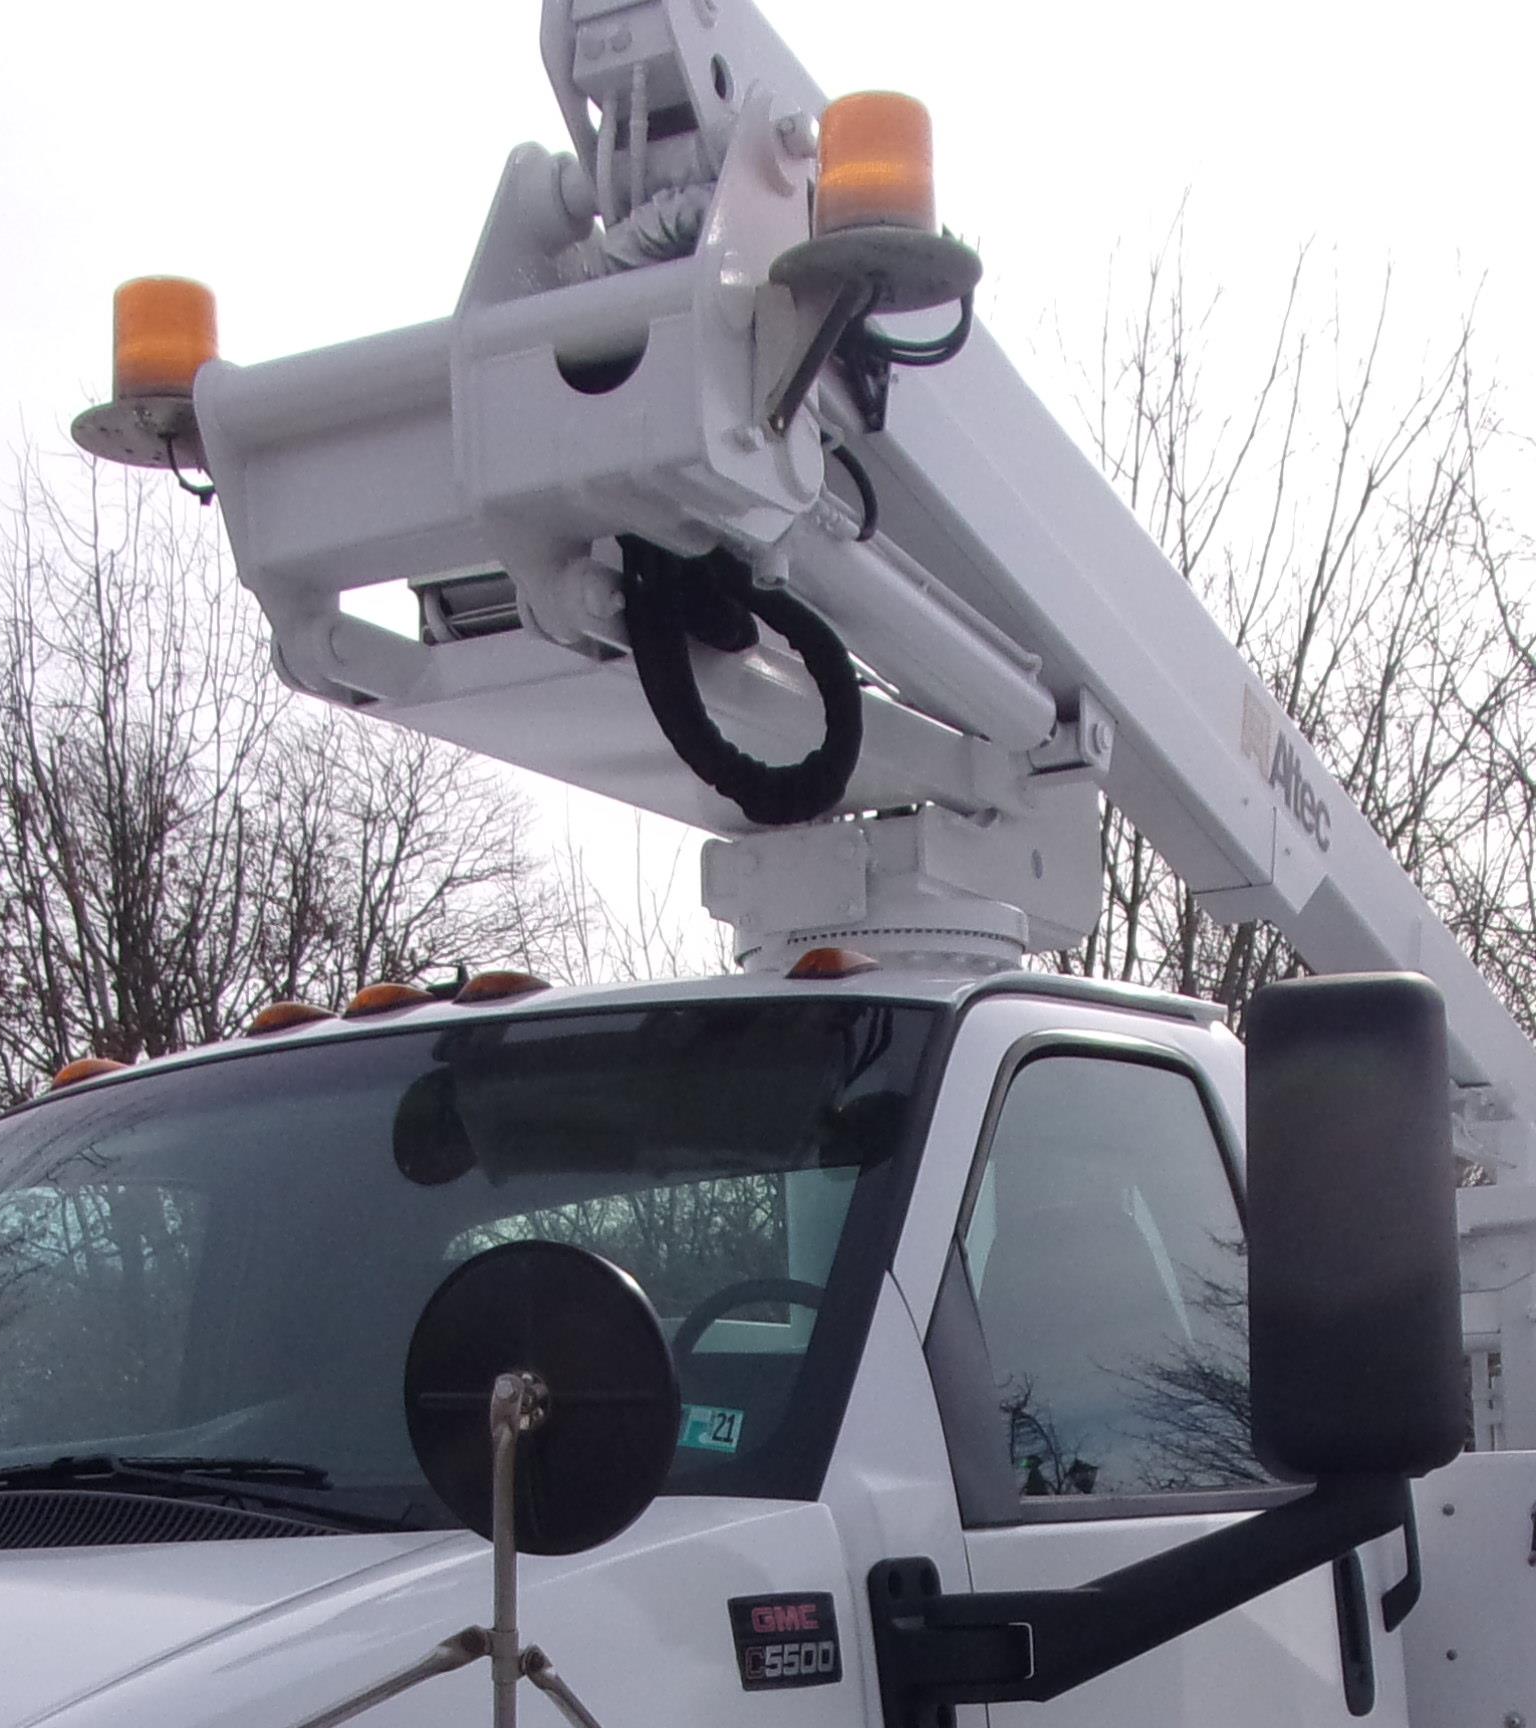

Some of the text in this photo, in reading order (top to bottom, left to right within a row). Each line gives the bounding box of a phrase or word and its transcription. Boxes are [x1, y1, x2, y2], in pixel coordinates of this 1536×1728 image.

[1268, 728, 1332, 853] Altec
[712, 1412, 736, 1444] 21
[751, 1604, 820, 1633] GMC
[744, 1640, 835, 1680] C5500
